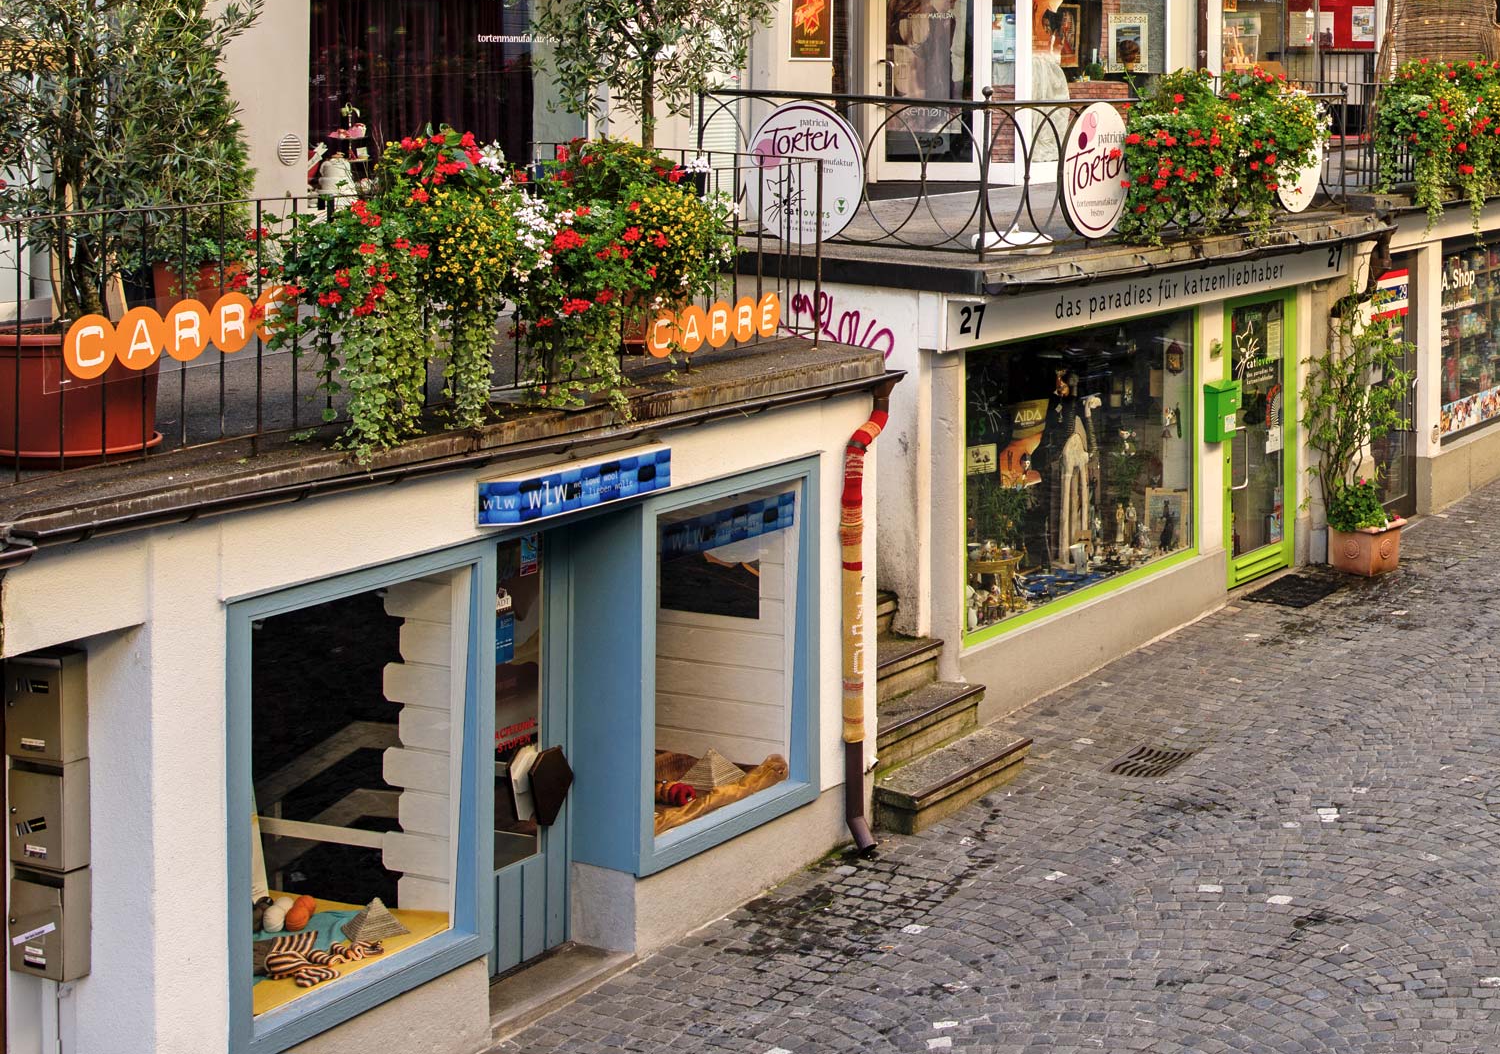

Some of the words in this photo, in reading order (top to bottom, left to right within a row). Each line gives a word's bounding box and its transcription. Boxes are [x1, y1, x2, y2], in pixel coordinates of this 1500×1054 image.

[800, 119, 829, 128] patricia
[814, 166, 834, 174] btro
[1090, 208, 1105, 217] bistro
[1327, 246, 1343, 272] 27
[1452, 268, 1476, 289] Shop
[1055, 293, 1082, 319] das
[1089, 285, 1152, 320] paradies
[1158, 276, 1178, 306] für
[1183, 262, 1285, 296] katzenliebhaber
[1399, 284, 1408, 300] 29
[653, 293, 775, 350] CARRÉ
[960, 303, 987, 340] 27
[1014, 409, 1042, 423] AIDA
[528, 481, 568, 509] wlw
